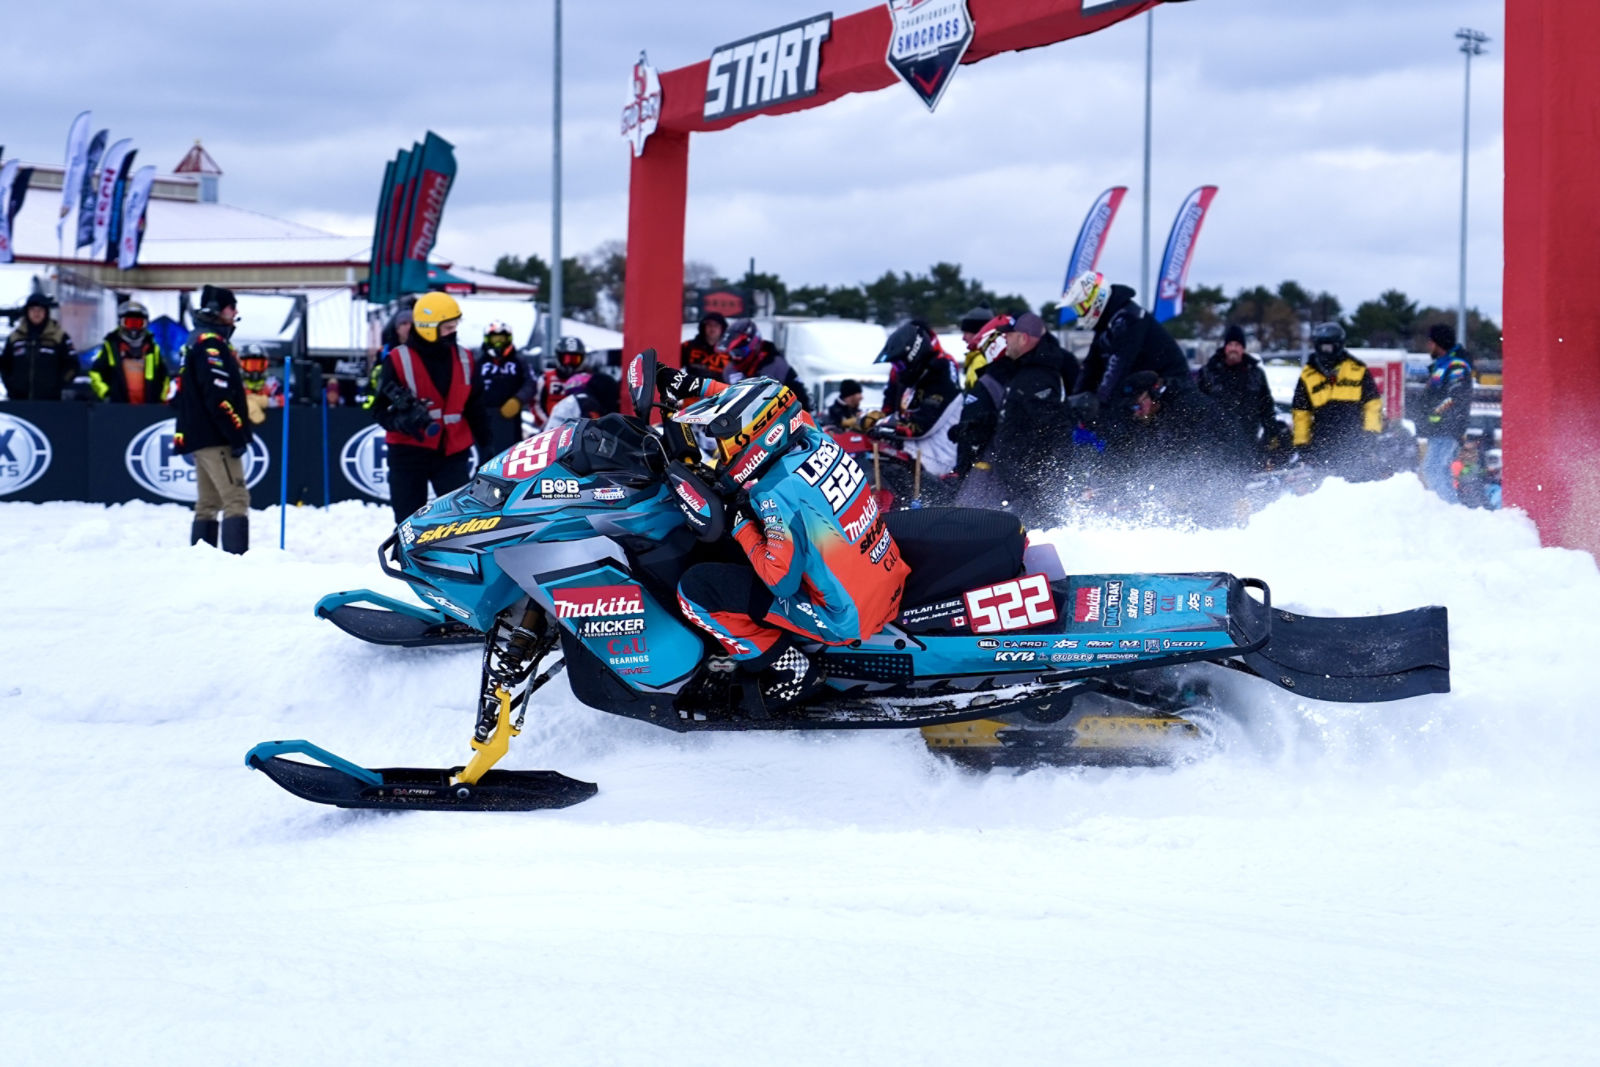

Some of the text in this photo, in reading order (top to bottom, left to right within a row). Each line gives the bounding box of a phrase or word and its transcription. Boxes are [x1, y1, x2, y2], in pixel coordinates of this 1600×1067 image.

[897, 17, 959, 55] SNOCROSS
[704, 19, 829, 117] START
[481, 361, 516, 376] FXR
[767, 427, 782, 443] BELL
[541, 479, 580, 493] BOB
[820, 452, 865, 514] 522
[416, 516, 501, 543] ski-doo
[903, 600, 963, 617] DYLAN LEBEL
[967, 575, 1055, 632] 522
[1105, 582, 1121, 626] MAKTRAK
[590, 619, 644, 633] KICKER
[607, 637, 647, 655] C&U
[610, 655, 649, 664] BEARINGS
[995, 651, 1035, 661] KYB
